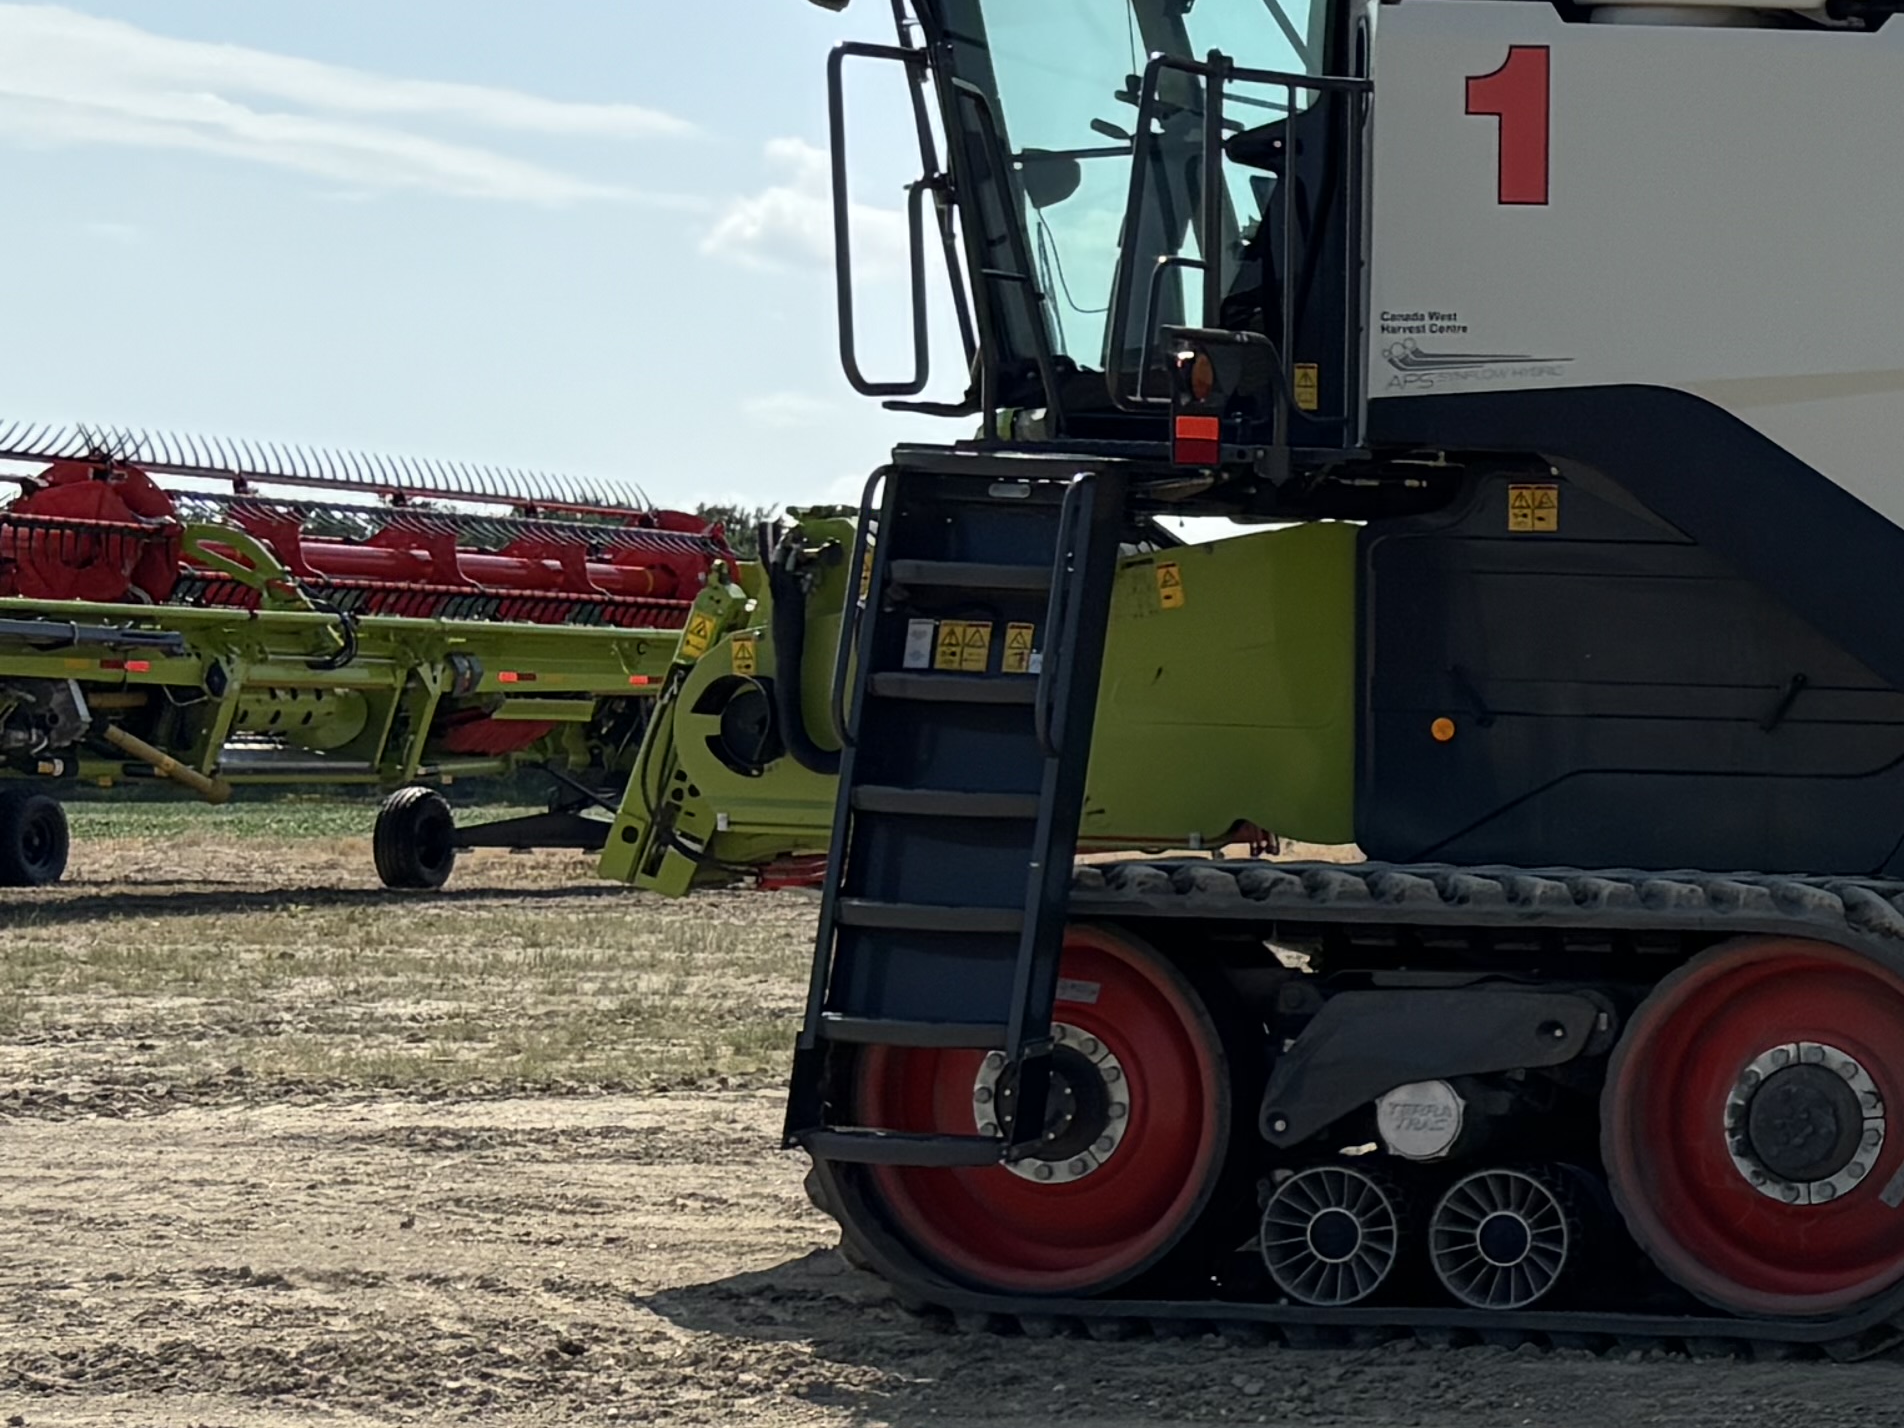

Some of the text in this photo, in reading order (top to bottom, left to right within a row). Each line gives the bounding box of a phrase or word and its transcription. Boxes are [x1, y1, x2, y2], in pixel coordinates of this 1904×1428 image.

[1465, 44, 1550, 205] 1
[1380, 311, 1457, 322] Canada West
[1380, 323, 1468, 334] Harvest Centre
[1385, 372, 1434, 390] APS
